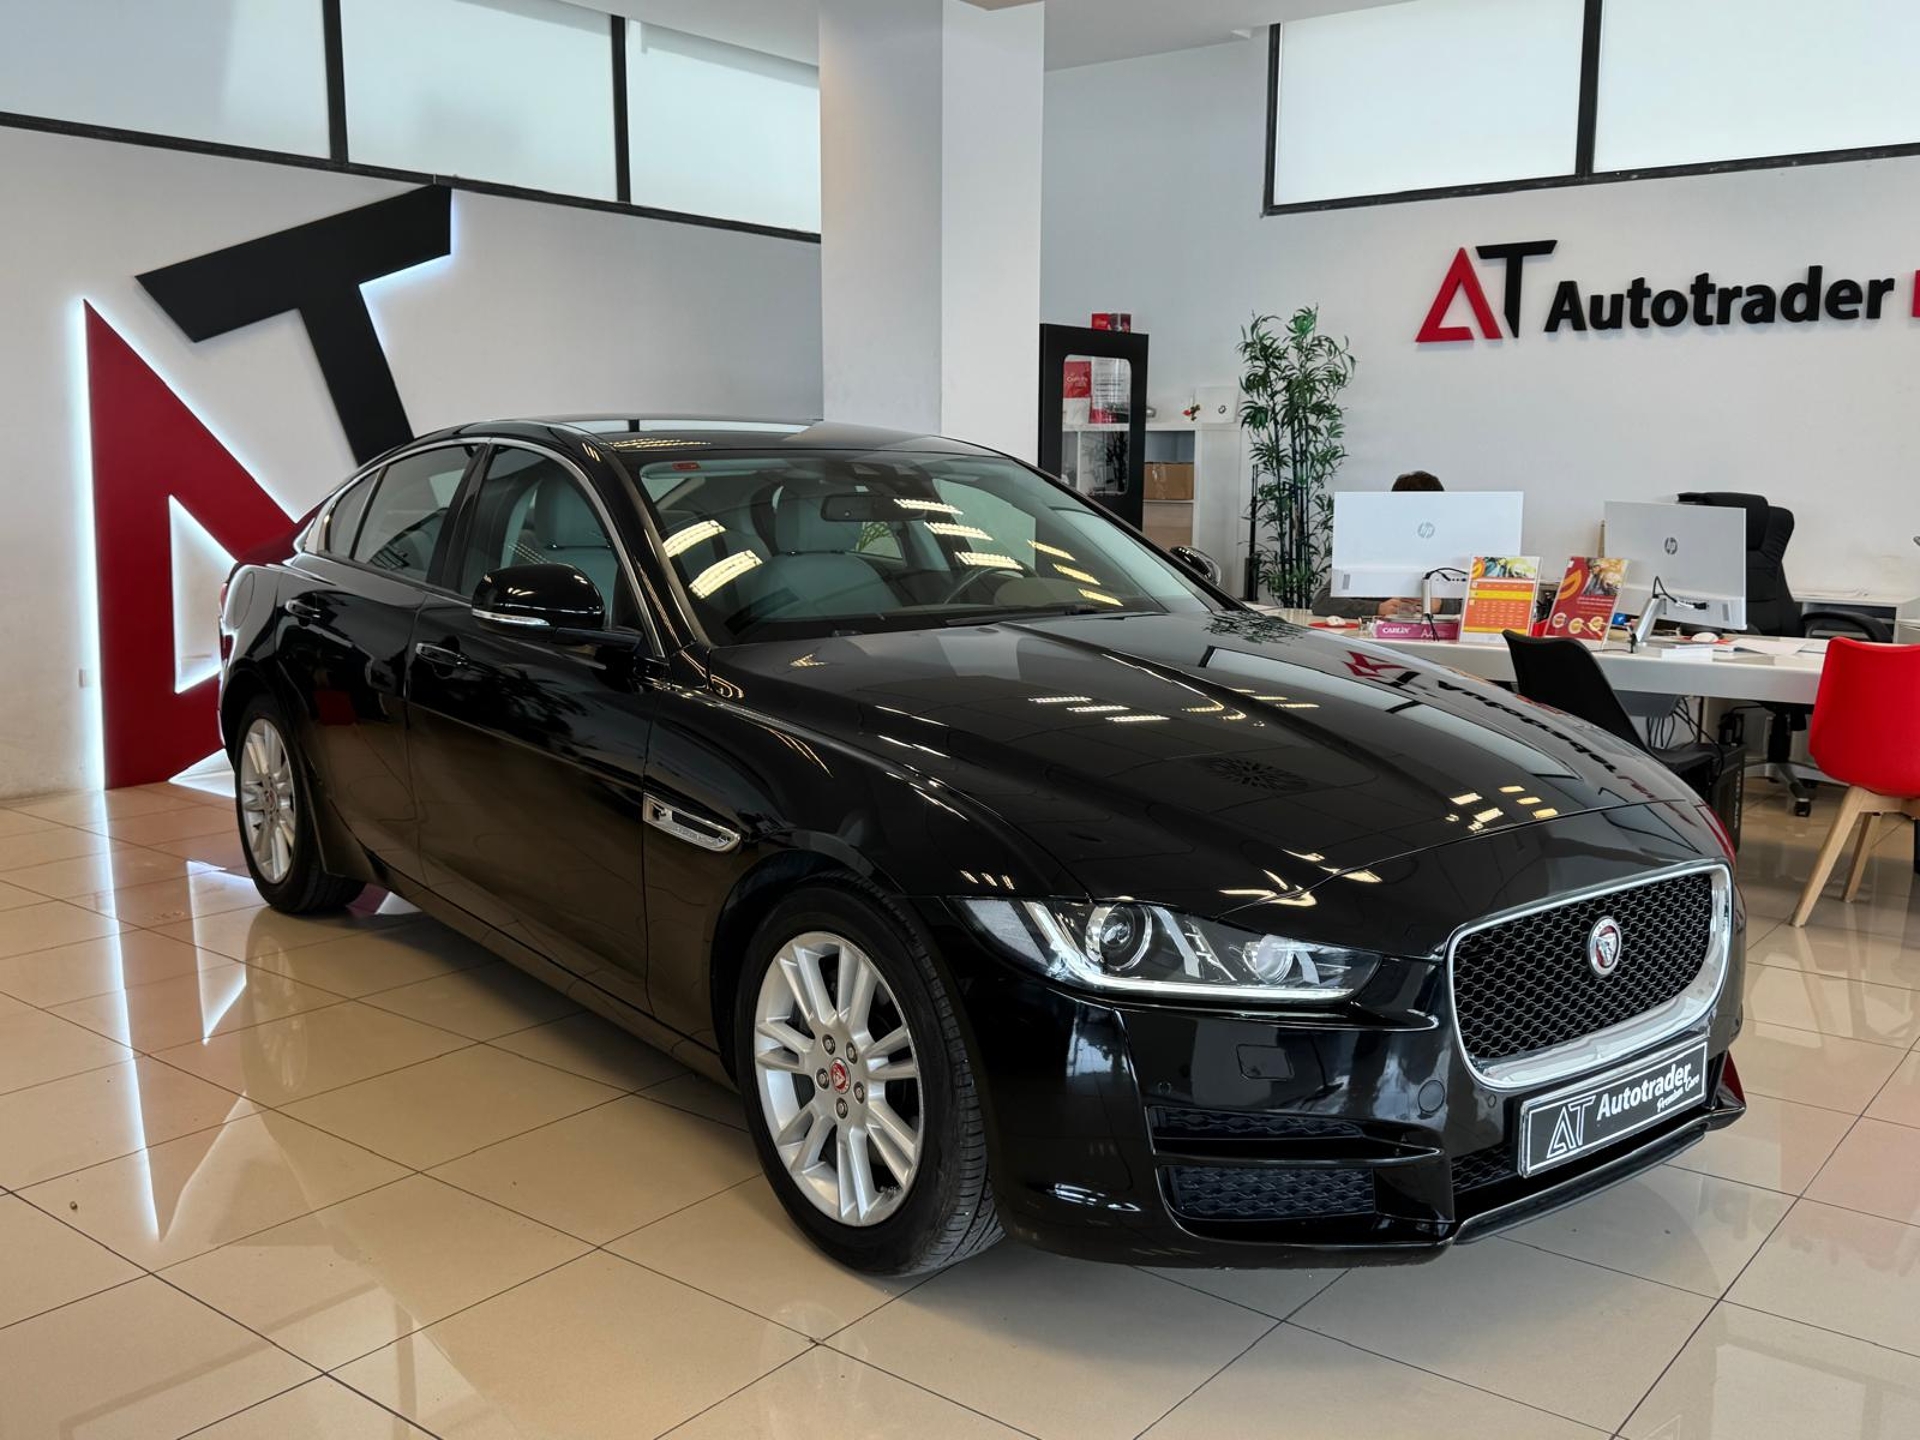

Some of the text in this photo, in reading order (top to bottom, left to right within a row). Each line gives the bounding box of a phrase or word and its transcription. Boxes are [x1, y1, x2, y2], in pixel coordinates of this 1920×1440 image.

[1415, 240, 1558, 343] AT
[1543, 265, 1896, 334] Autotrader
[1546, 1063, 1692, 1159] AT Autotrader
